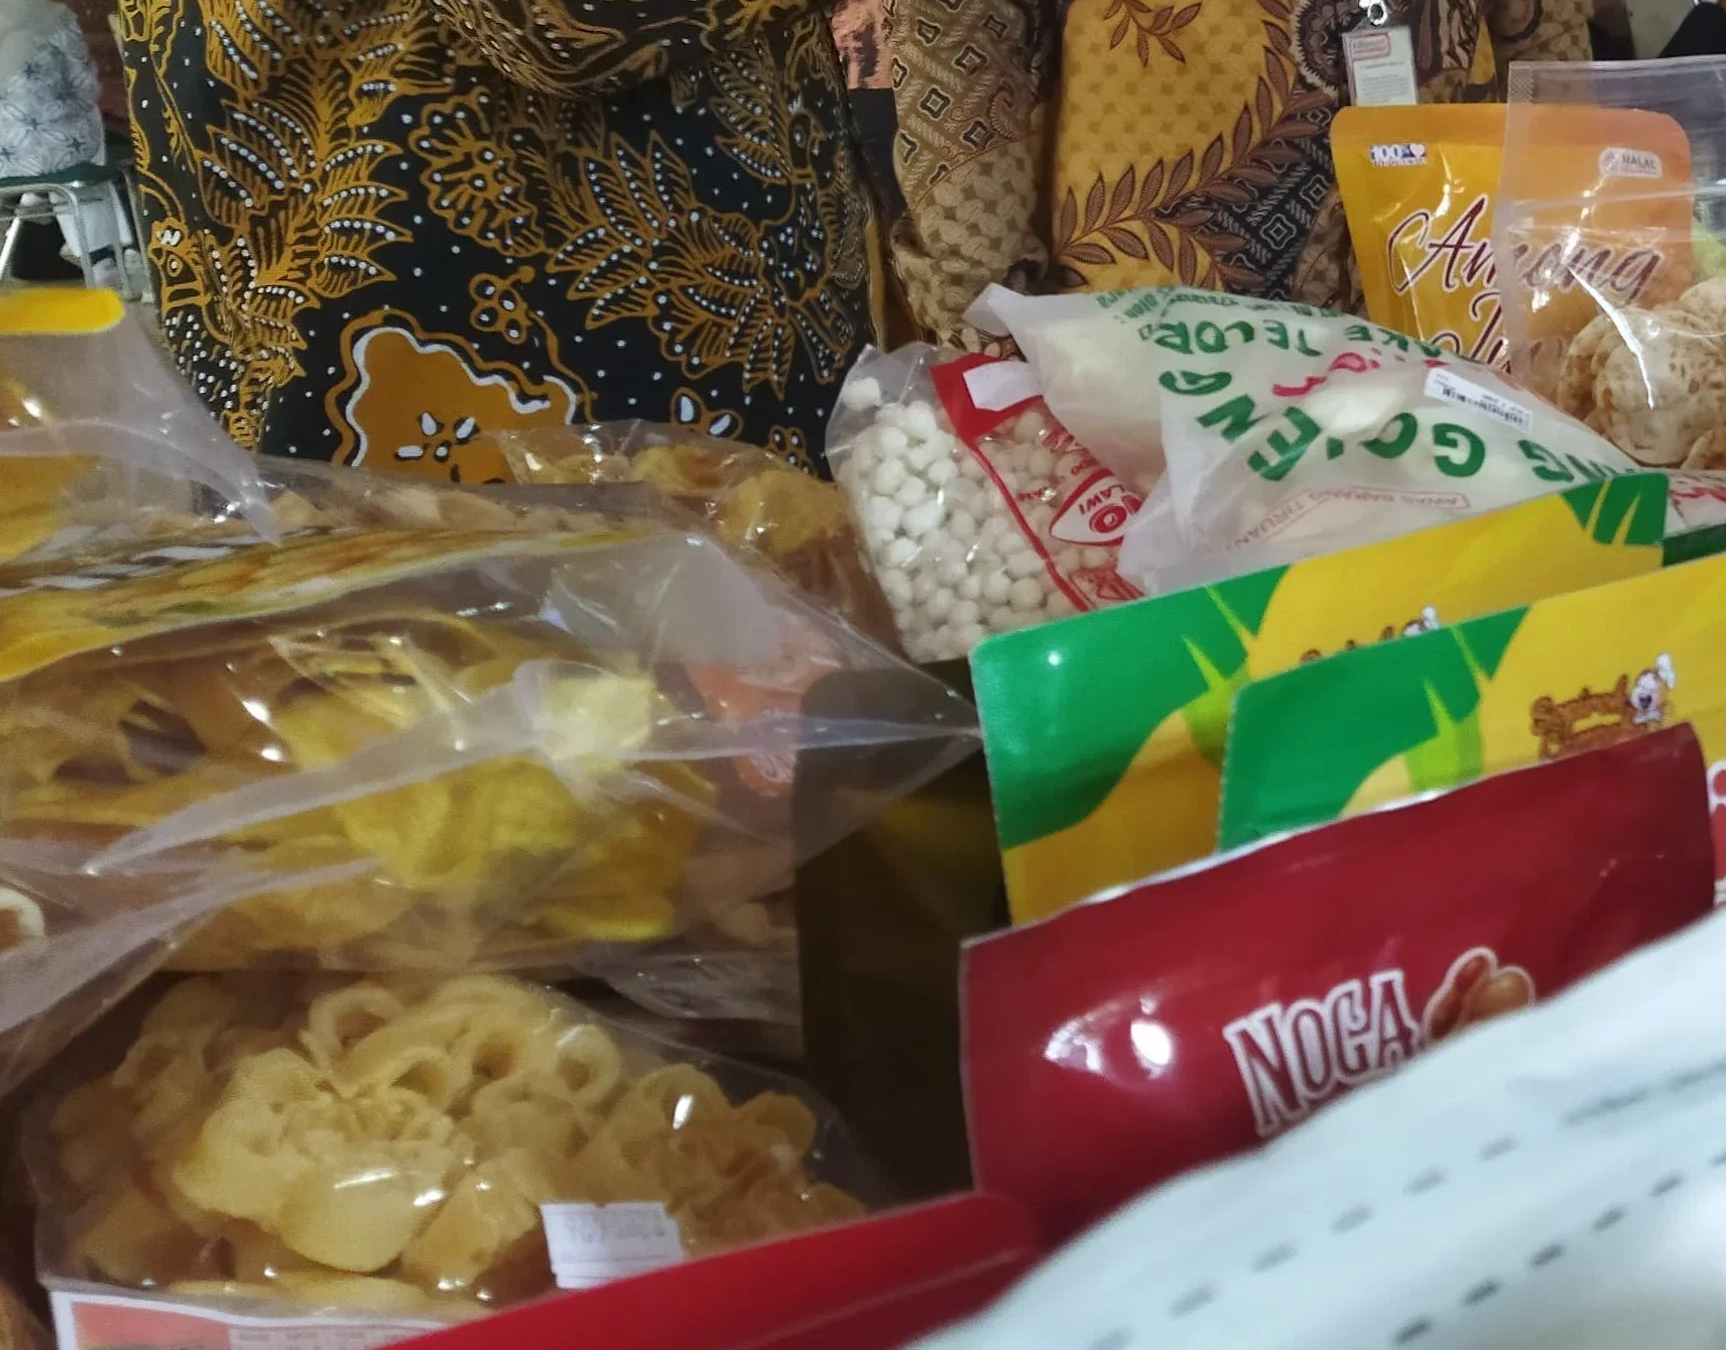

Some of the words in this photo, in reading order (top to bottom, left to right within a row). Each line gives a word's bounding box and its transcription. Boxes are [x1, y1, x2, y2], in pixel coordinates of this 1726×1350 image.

[1621, 153, 1657, 171] HALAL
[1386, 194, 1665, 306] Among
[1154, 321, 1323, 357] TELOR
[1516, 439, 1621, 483] NG
[1079, 484, 1125, 516] LAWI
[1222, 968, 1424, 1138] NOGA
